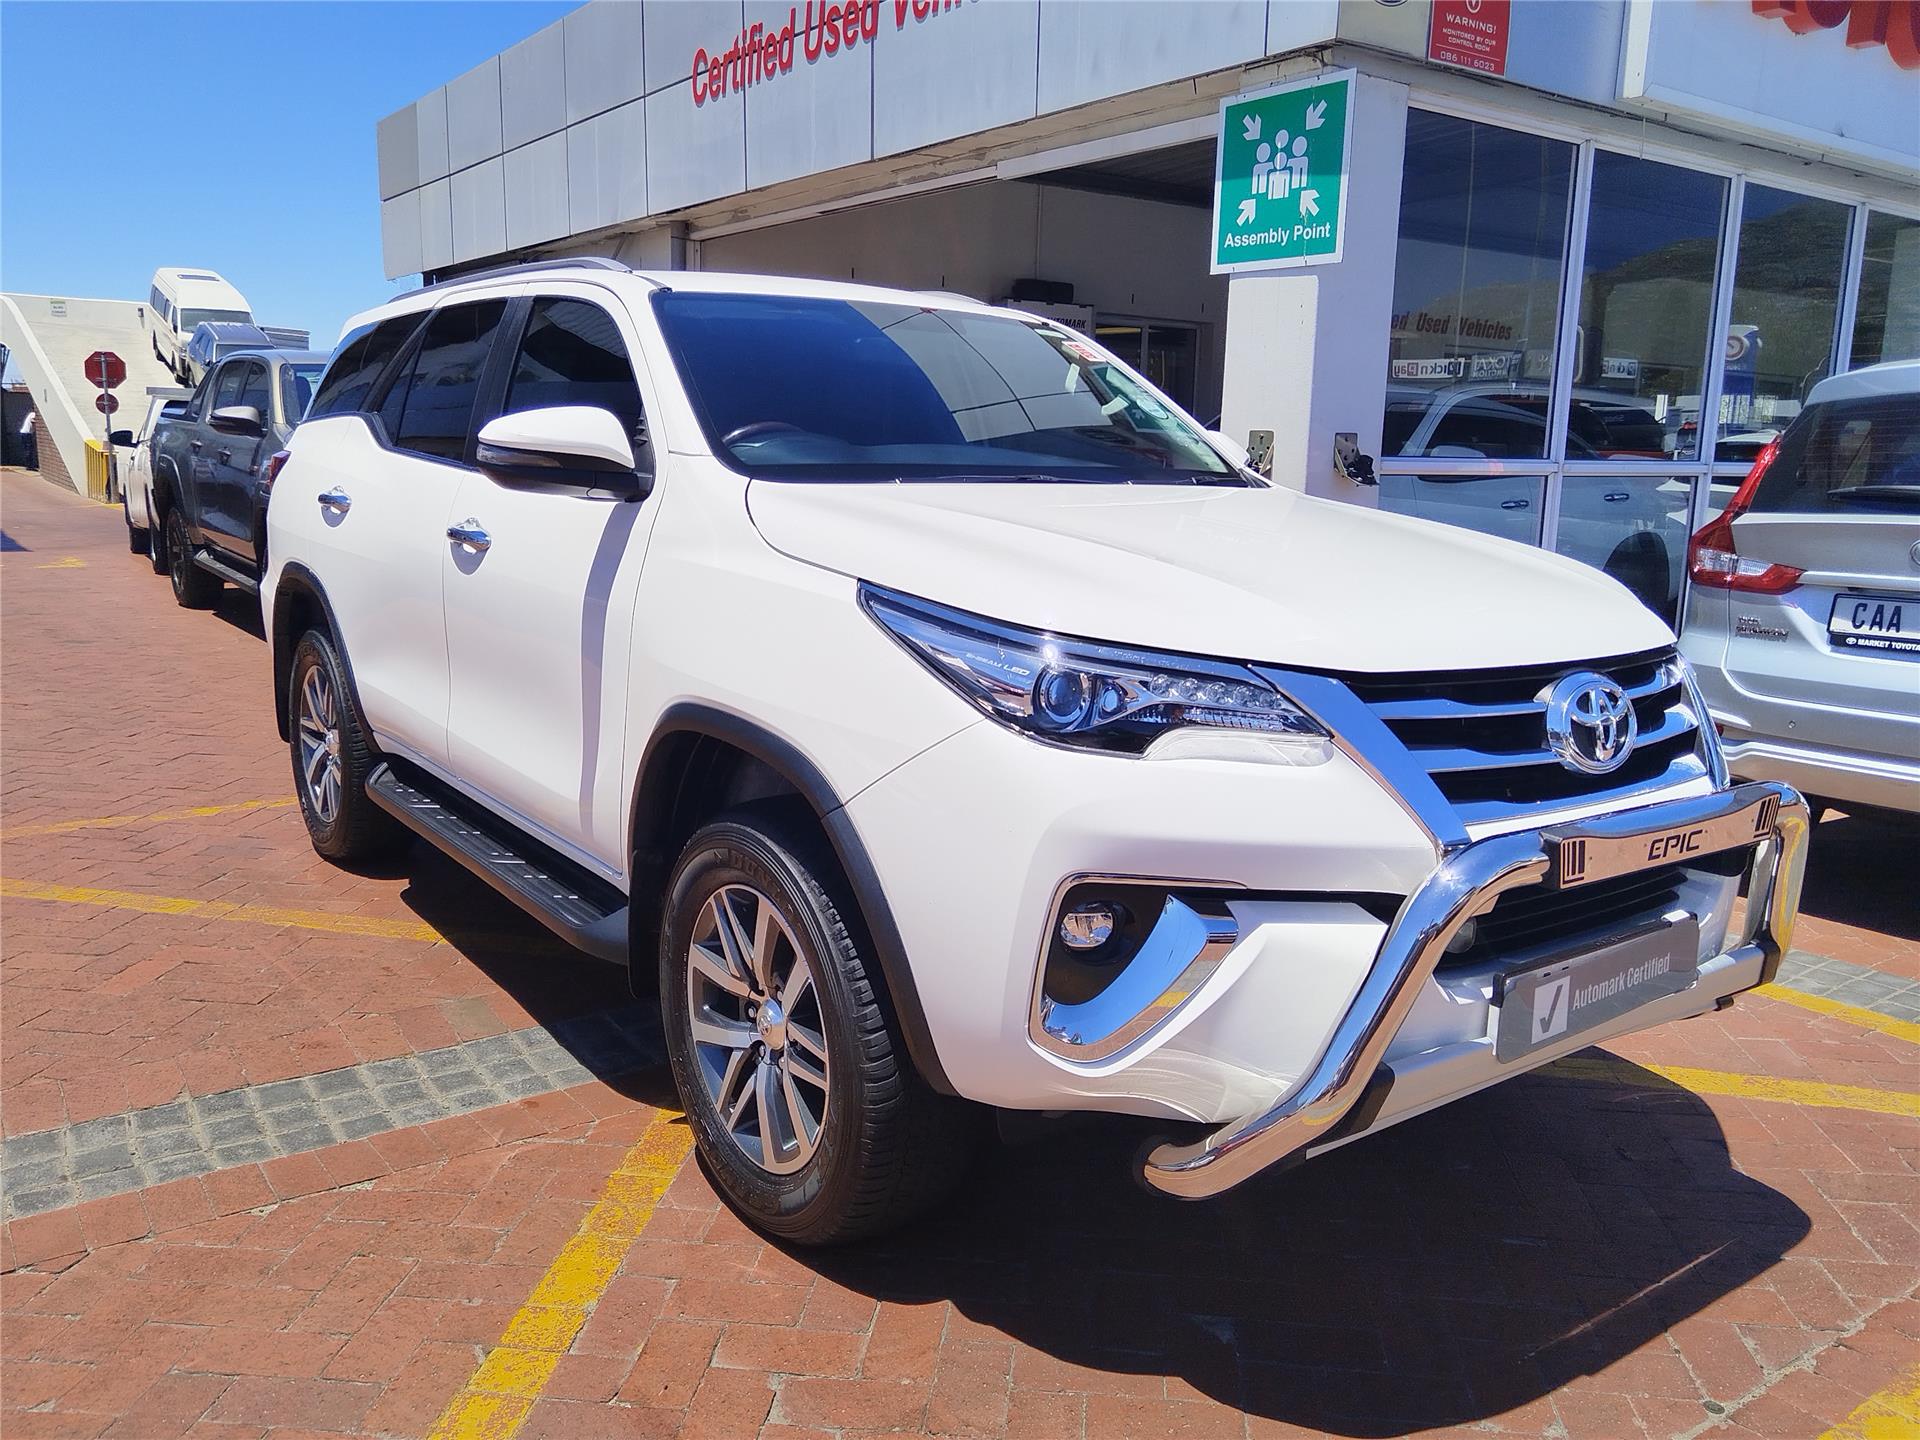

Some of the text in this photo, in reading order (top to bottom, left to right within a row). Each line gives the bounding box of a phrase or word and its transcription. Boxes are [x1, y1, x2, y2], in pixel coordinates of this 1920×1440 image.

[1446, 12, 1497, 34] WARNING!
[1442, 27, 1475, 41] MONITORED
[1484, 38, 1496, 46] OUR
[1448, 37, 1490, 52] CONTROL ROOM
[692, 0, 880, 106] Certified Used
[1440, 51, 1495, 71] 086 111 6023
[1224, 222, 1331, 248] Assembly Point
[1416, 312, 1451, 335] Used
[1458, 317, 1513, 340] Vehicles
[1852, 602, 1903, 633] CAA
[1857, 638, 1920, 651] MARKET TOYOTA
[1647, 829, 1703, 861] EPIC
[1572, 952, 1671, 1011] Automark Certified
